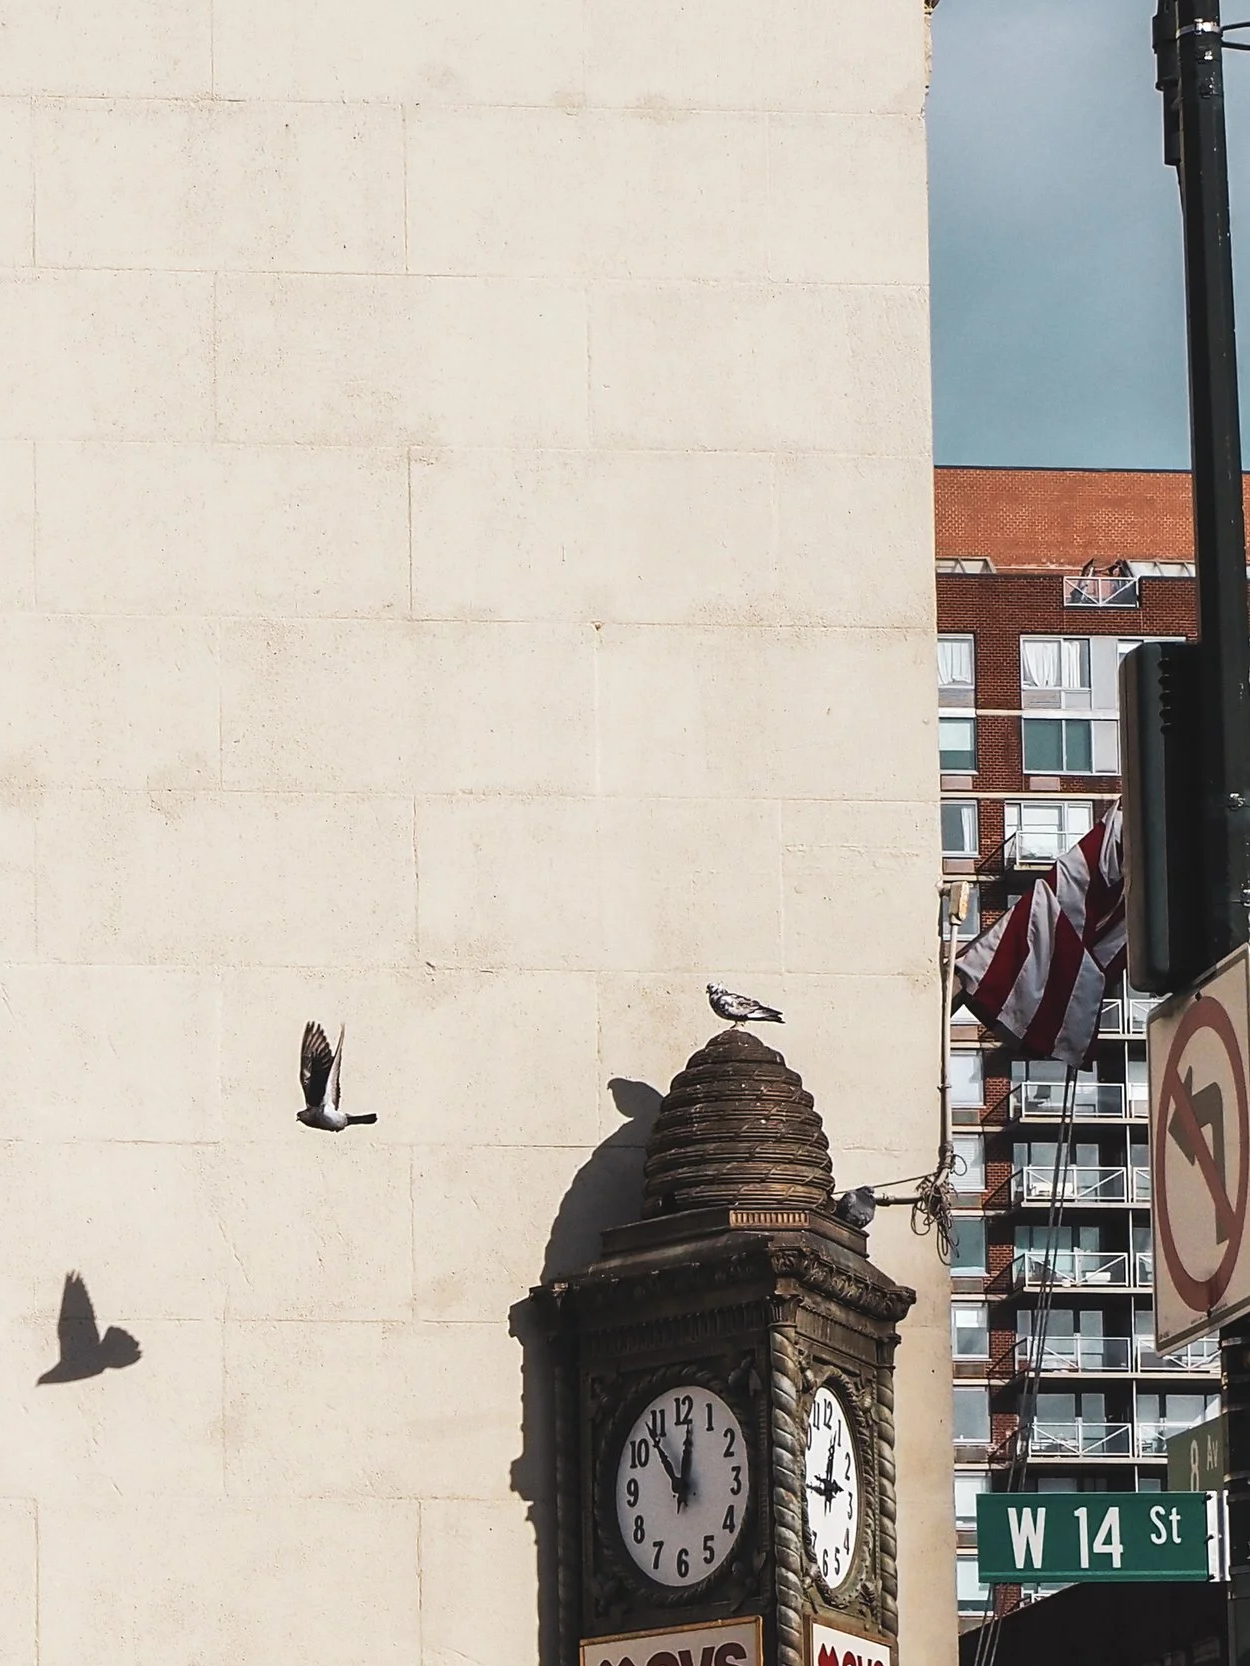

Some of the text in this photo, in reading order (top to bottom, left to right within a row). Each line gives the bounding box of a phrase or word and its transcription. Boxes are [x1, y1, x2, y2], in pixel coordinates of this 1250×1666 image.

[651, 1409, 667, 1438] 11
[674, 1395, 693, 1426] 12
[706, 1403, 714, 1432] 1
[813, 1399, 821, 1431] 11
[823, 1398, 833, 1430] 12
[723, 1428, 735, 1458] 2
[837, 1419, 842, 1448] 1
[630, 1438, 649, 1469] 10
[845, 1451, 851, 1481] 2
[1190, 1440, 1199, 1491] 8
[627, 1478, 639, 1508] 9
[730, 1466, 742, 1496] 3
[722, 1505, 735, 1534] 4
[847, 1491, 853, 1520] 3
[633, 1515, 645, 1544] 8
[843, 1527, 850, 1556] 4
[1007, 1505, 1181, 1569] W 14 St
[653, 1540, 664, 1570] 7
[677, 1548, 689, 1578] 6
[703, 1535, 715, 1565] 5
[822, 1548, 829, 1578] 6
[834, 1547, 840, 1576] 5
